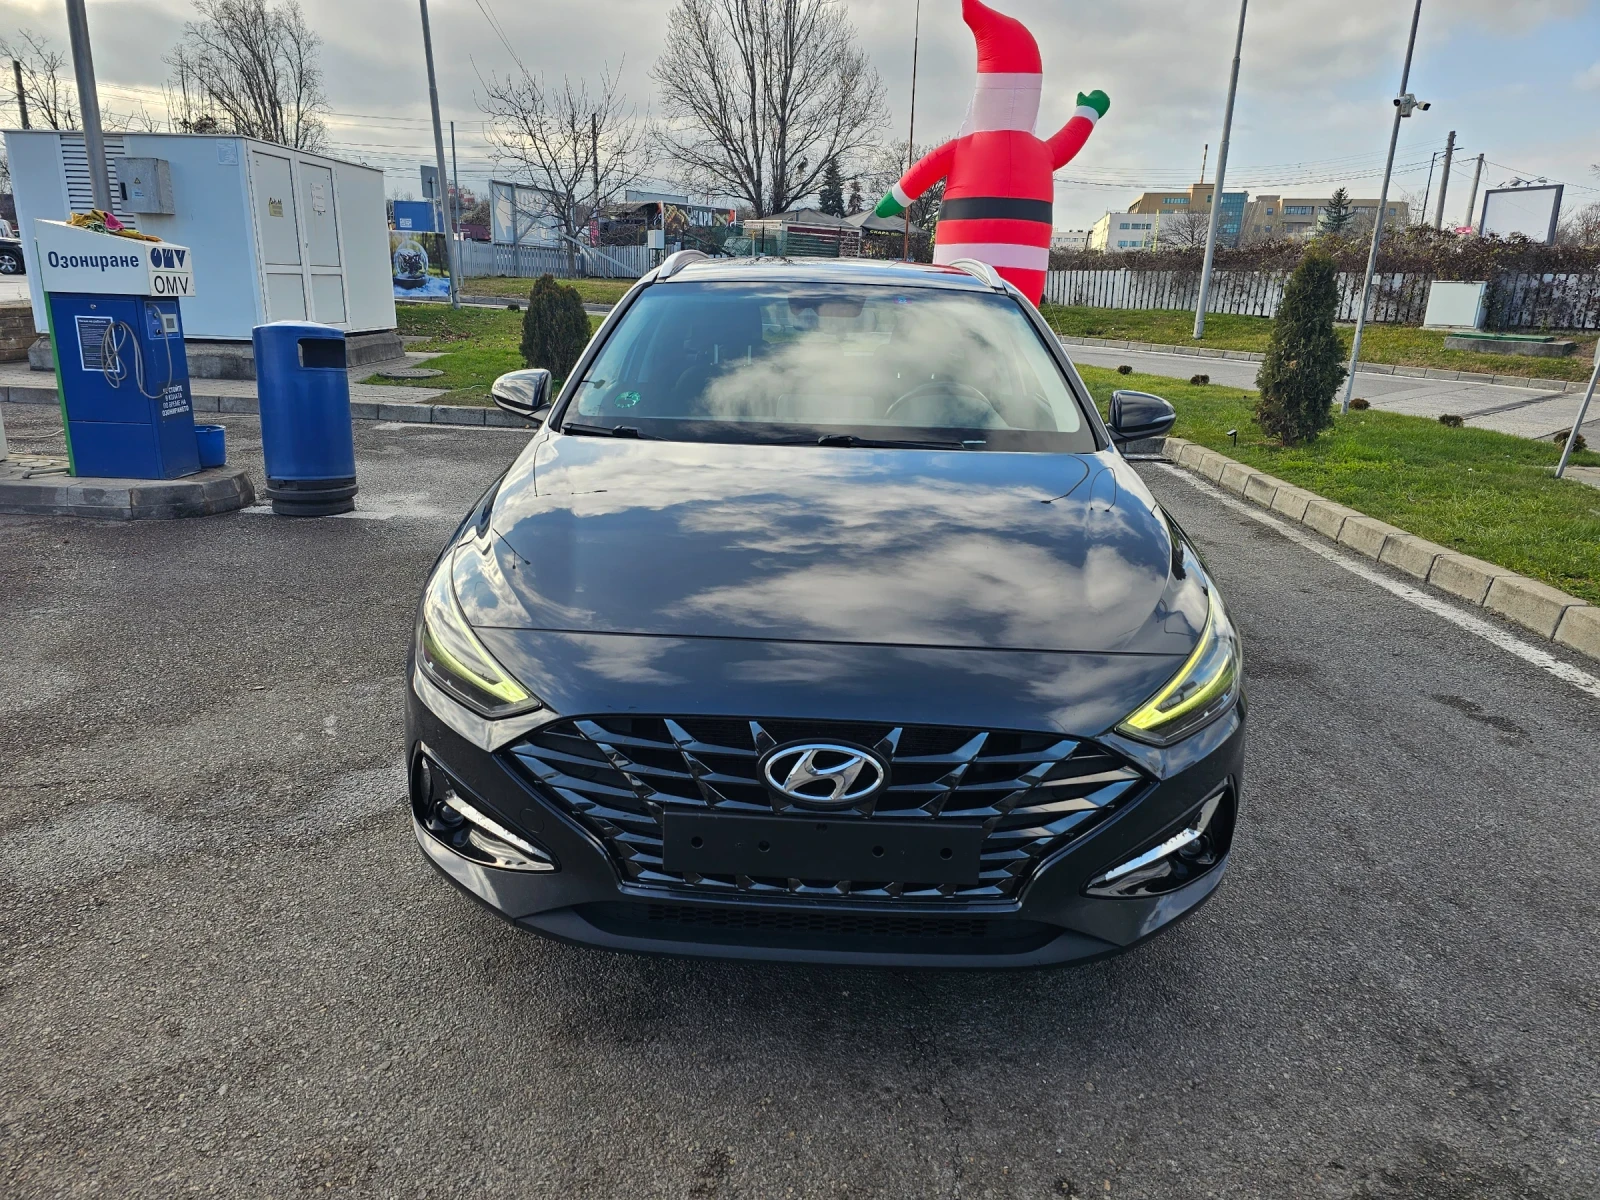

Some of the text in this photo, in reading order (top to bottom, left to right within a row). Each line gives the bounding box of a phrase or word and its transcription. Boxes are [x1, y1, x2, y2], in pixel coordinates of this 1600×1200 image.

[47, 251, 139, 272] Озониране
[150, 247, 187, 269] OMV
[154, 275, 189, 294] OMV
[169, 400, 180, 408] ВРЕМЕ
